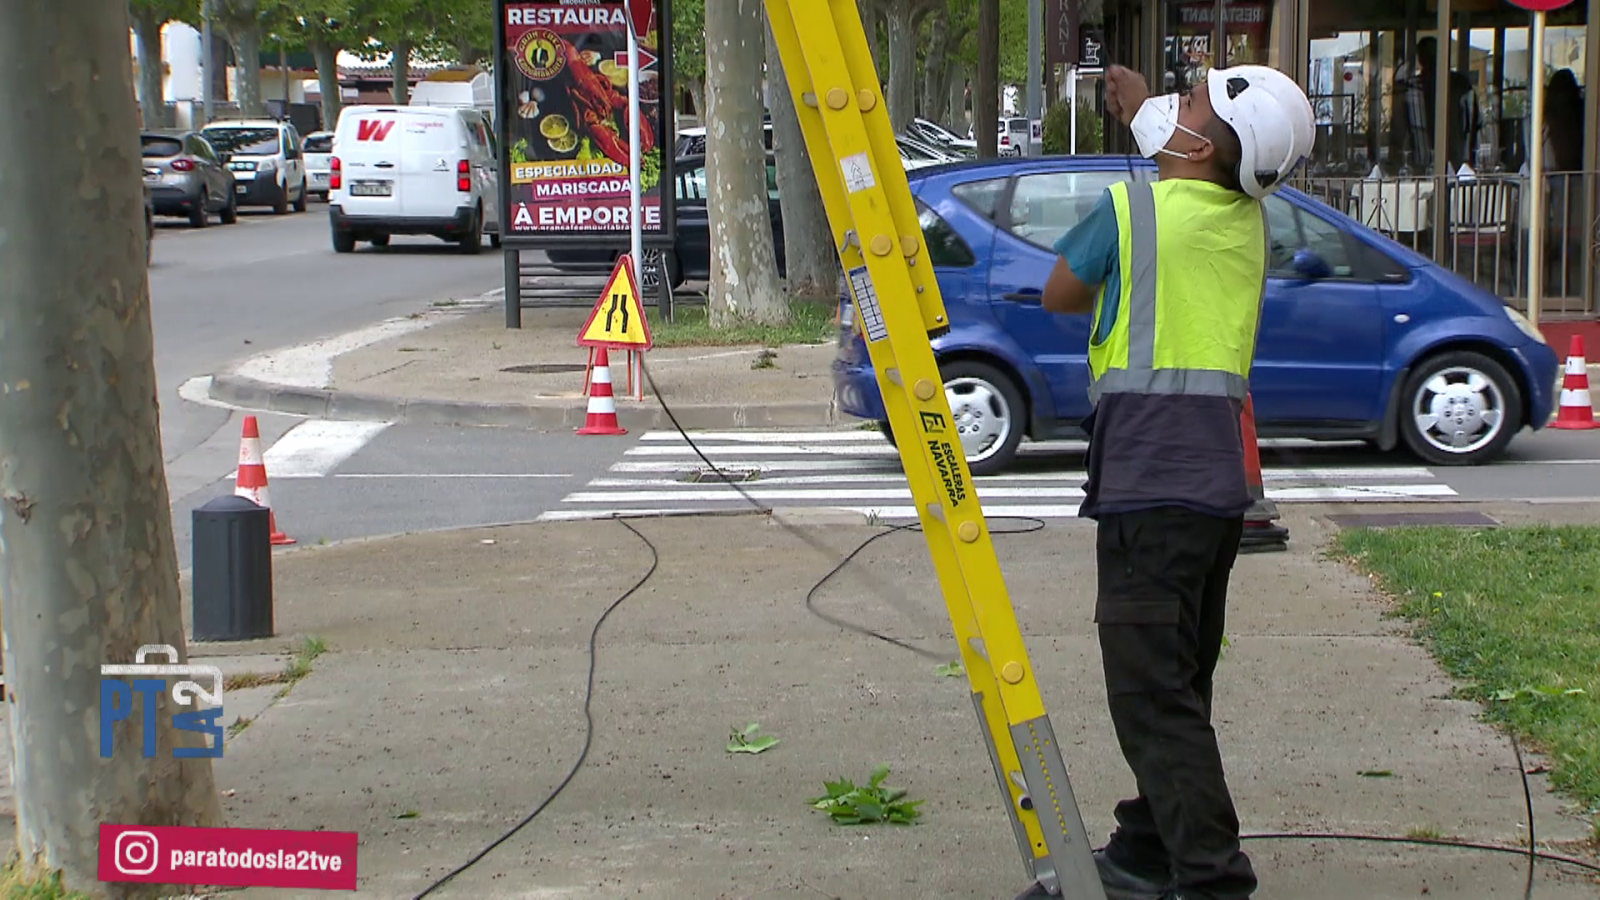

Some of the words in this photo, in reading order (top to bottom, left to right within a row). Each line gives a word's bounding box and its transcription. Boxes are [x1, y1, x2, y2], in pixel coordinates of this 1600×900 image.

[507, 8, 627, 25] RESTAURA
[515, 163, 624, 179] ESPECIALIDAD
[536, 180, 632, 197] MARISCADA
[514, 202, 533, 225] À
[538, 206, 661, 225] EMPORE
[927, 439, 959, 508] NAVARRA
[941, 442, 966, 501] ESCALERAS
